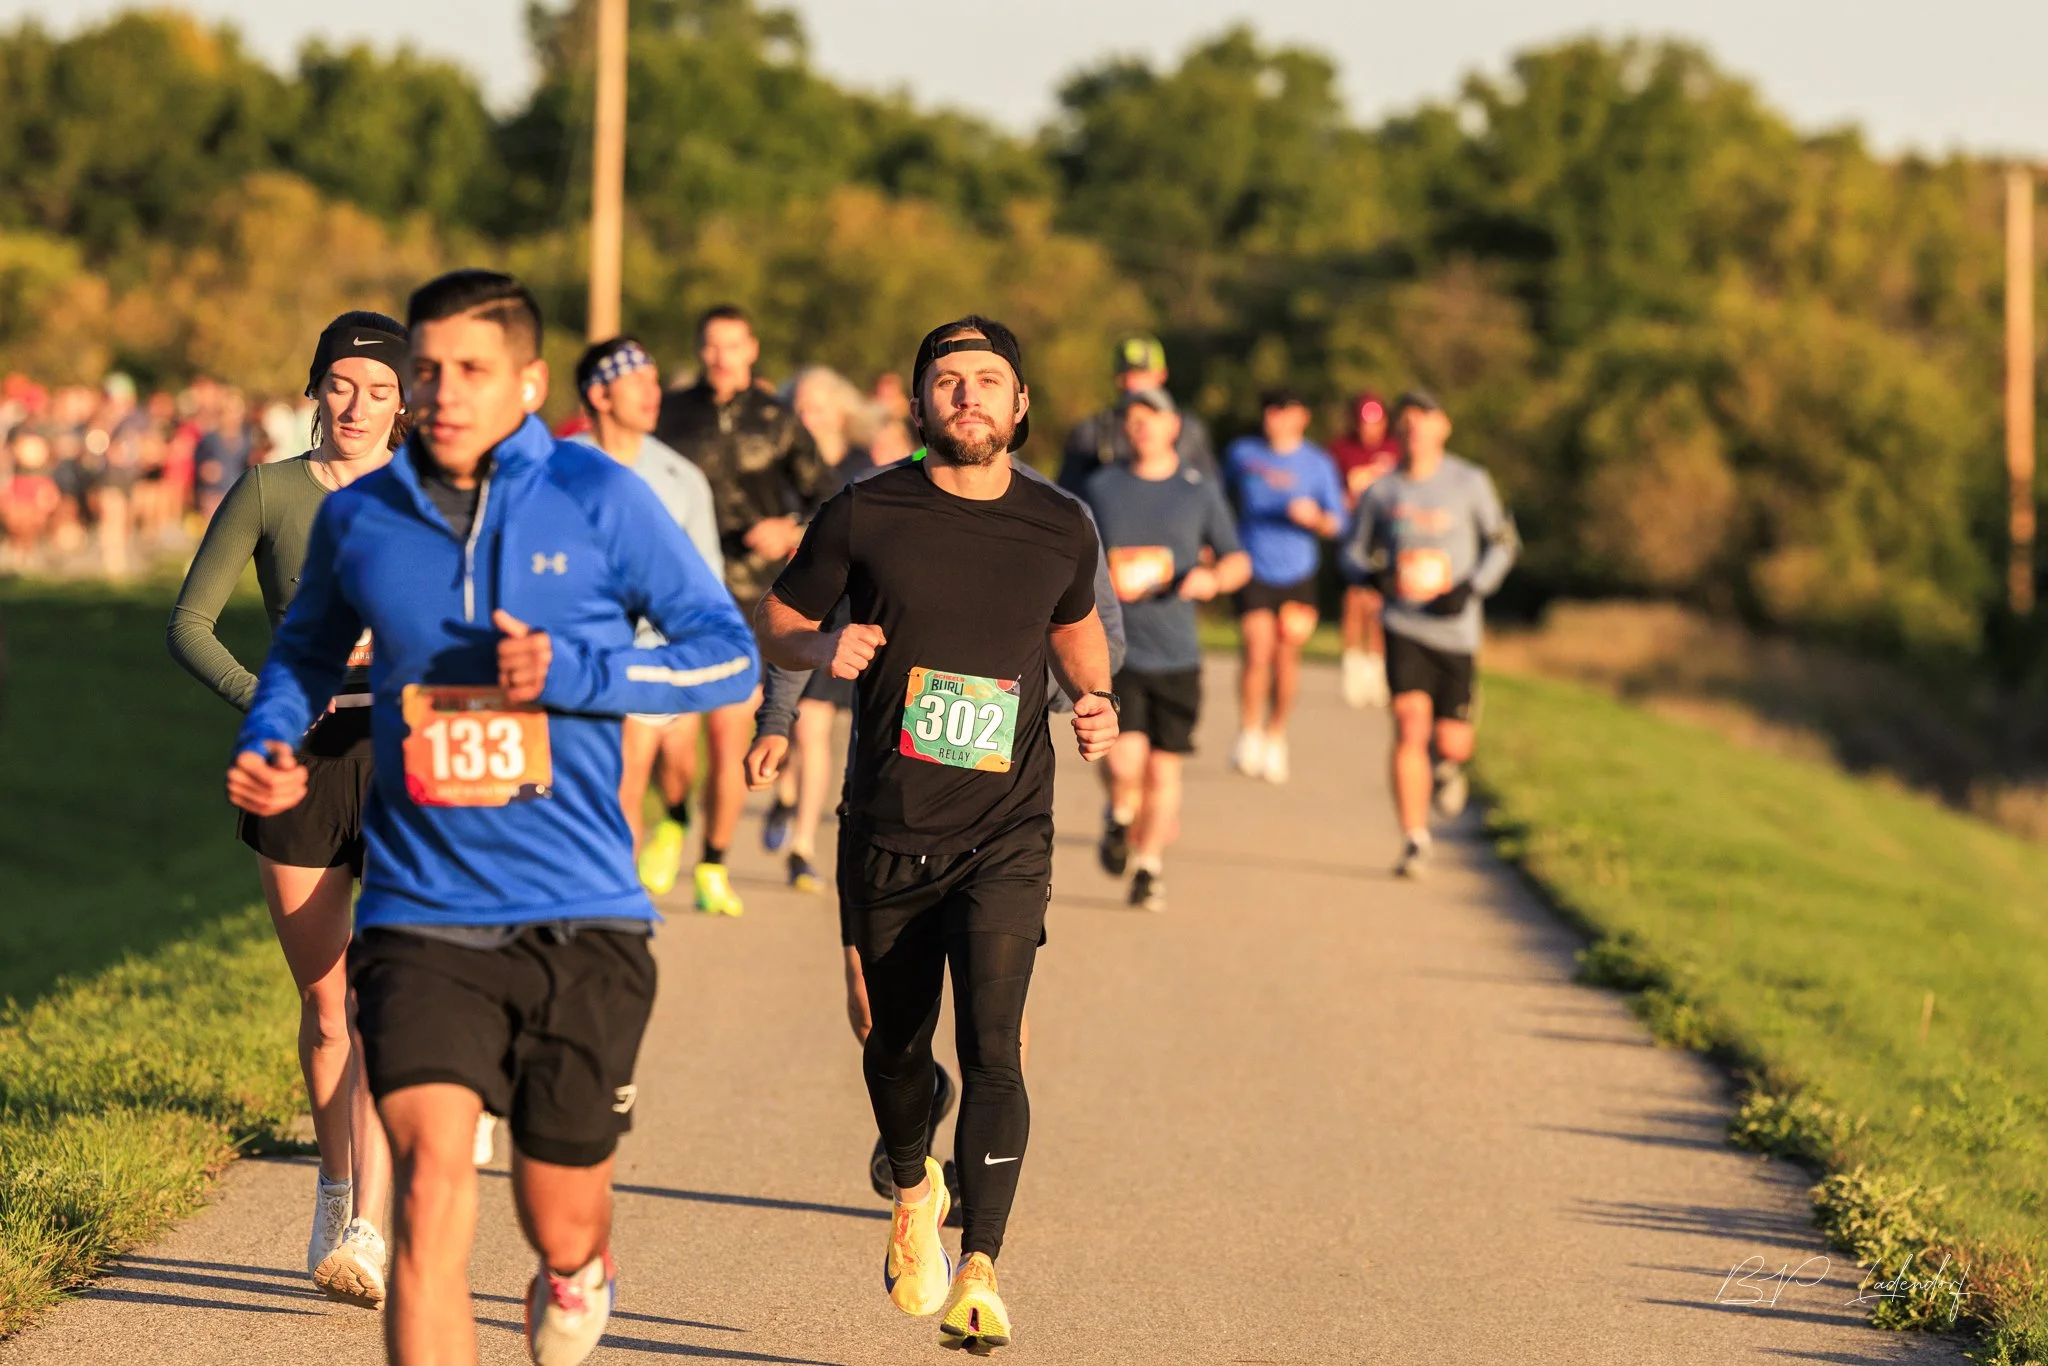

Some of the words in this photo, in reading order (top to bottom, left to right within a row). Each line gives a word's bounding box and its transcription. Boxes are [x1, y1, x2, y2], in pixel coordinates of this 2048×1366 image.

[423, 717, 526, 781] 133
[915, 694, 1005, 751] 302
[938, 748, 971, 762] RELAY
